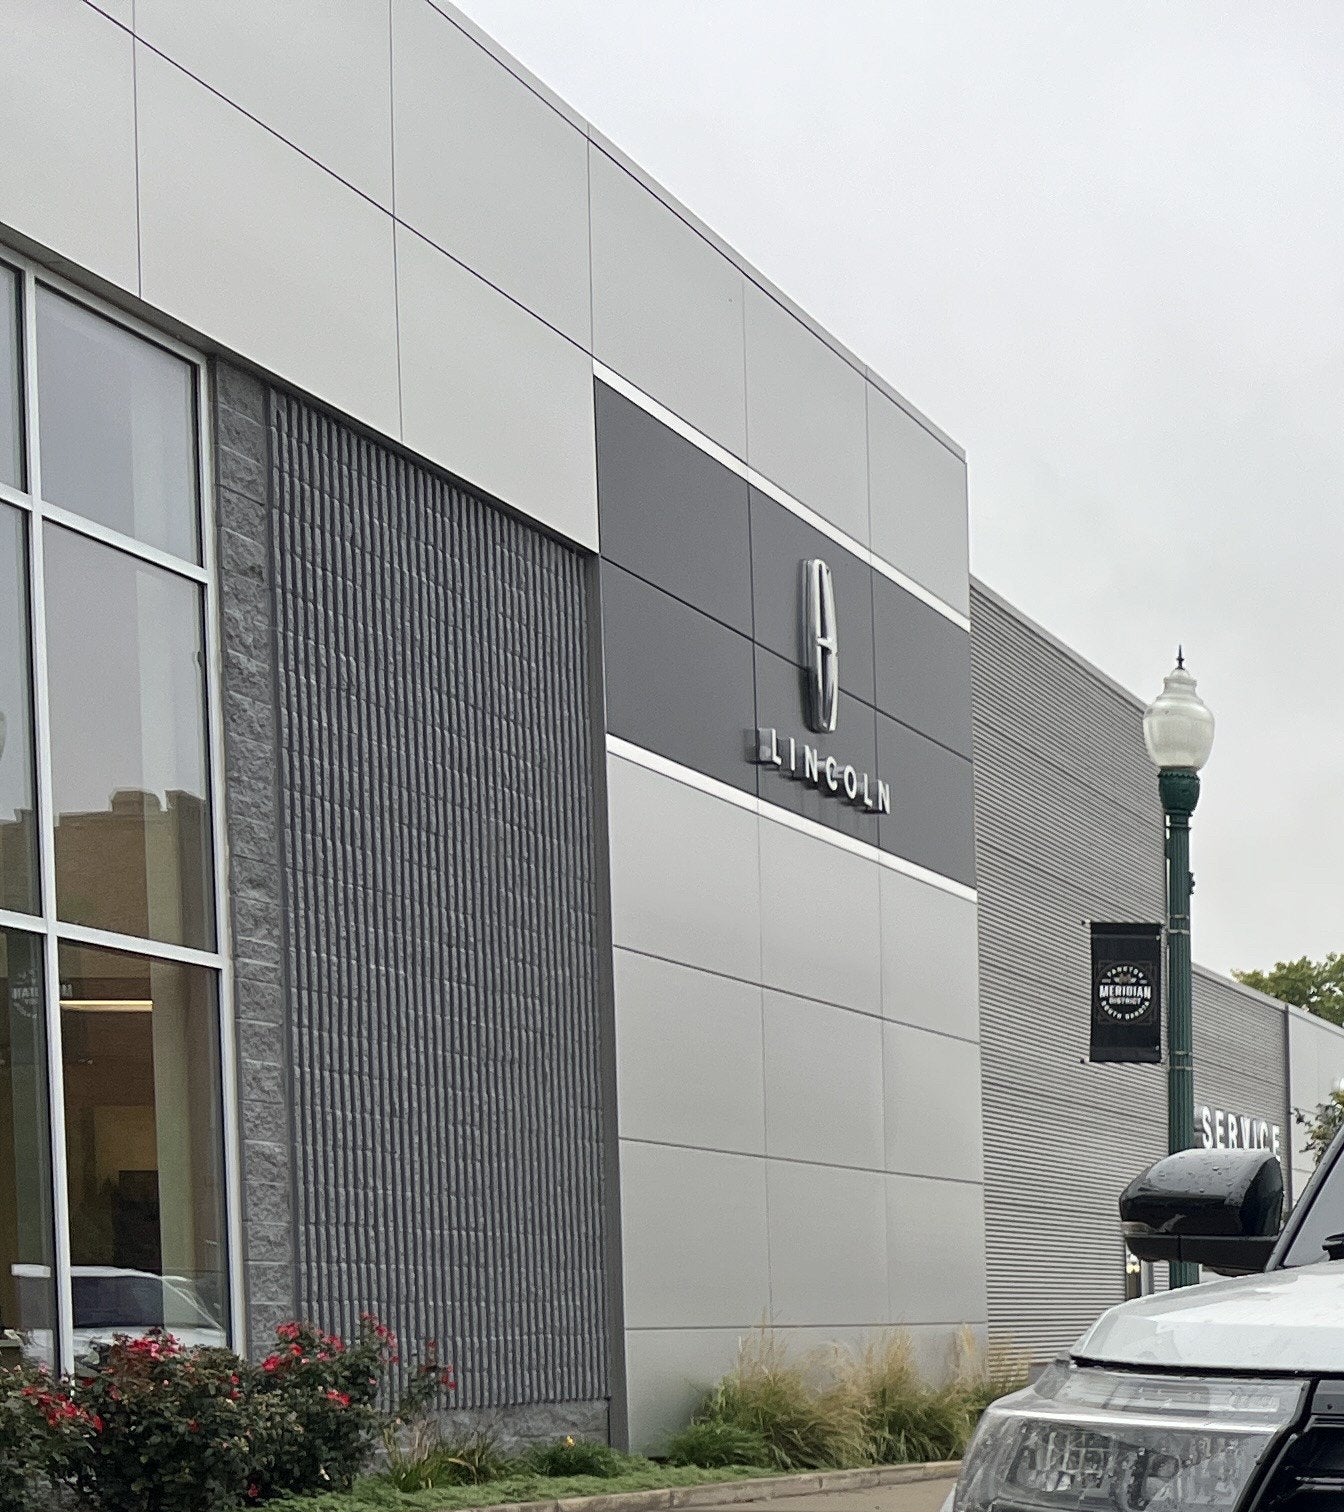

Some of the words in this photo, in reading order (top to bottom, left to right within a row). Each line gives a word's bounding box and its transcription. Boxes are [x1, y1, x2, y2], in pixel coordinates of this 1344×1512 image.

[770, 728, 891, 815] LINCOLN
[1099, 985, 1151, 999] MERIDIAN
[1202, 1105, 1281, 1162] SERVICE
